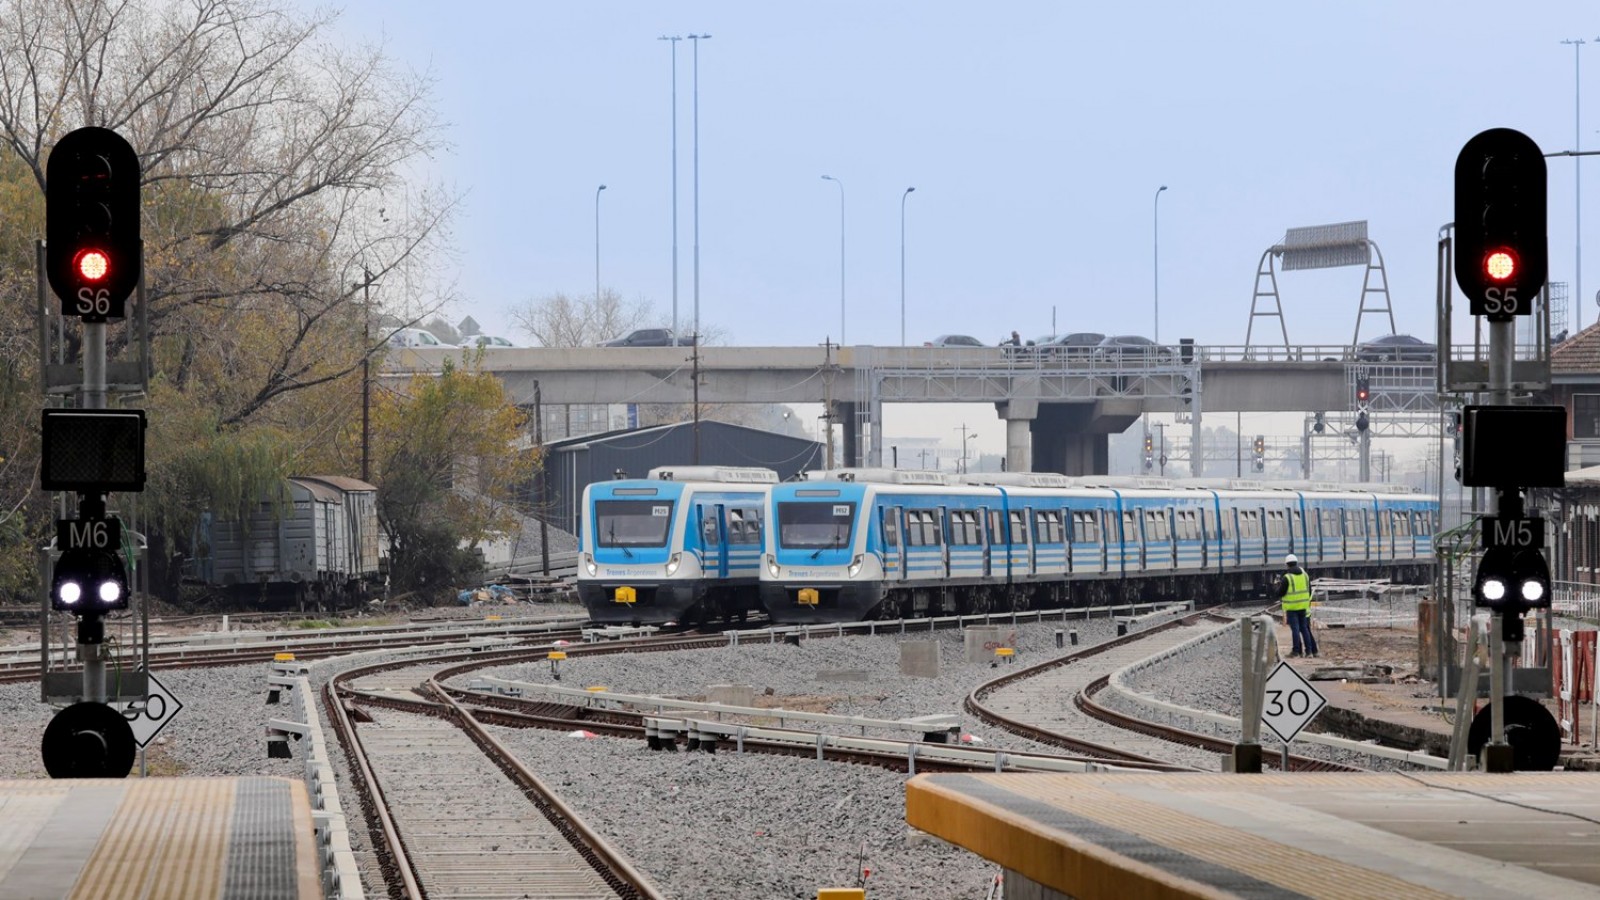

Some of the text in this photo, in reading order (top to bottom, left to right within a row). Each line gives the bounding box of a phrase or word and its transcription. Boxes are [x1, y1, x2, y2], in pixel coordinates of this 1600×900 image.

[76, 287, 110, 315] S6
[1484, 287, 1518, 313] S5
[70, 521, 108, 548] M6
[1494, 520, 1532, 546] M5
[606, 568, 626, 576] Trenes
[1265, 689, 1310, 717] 30
